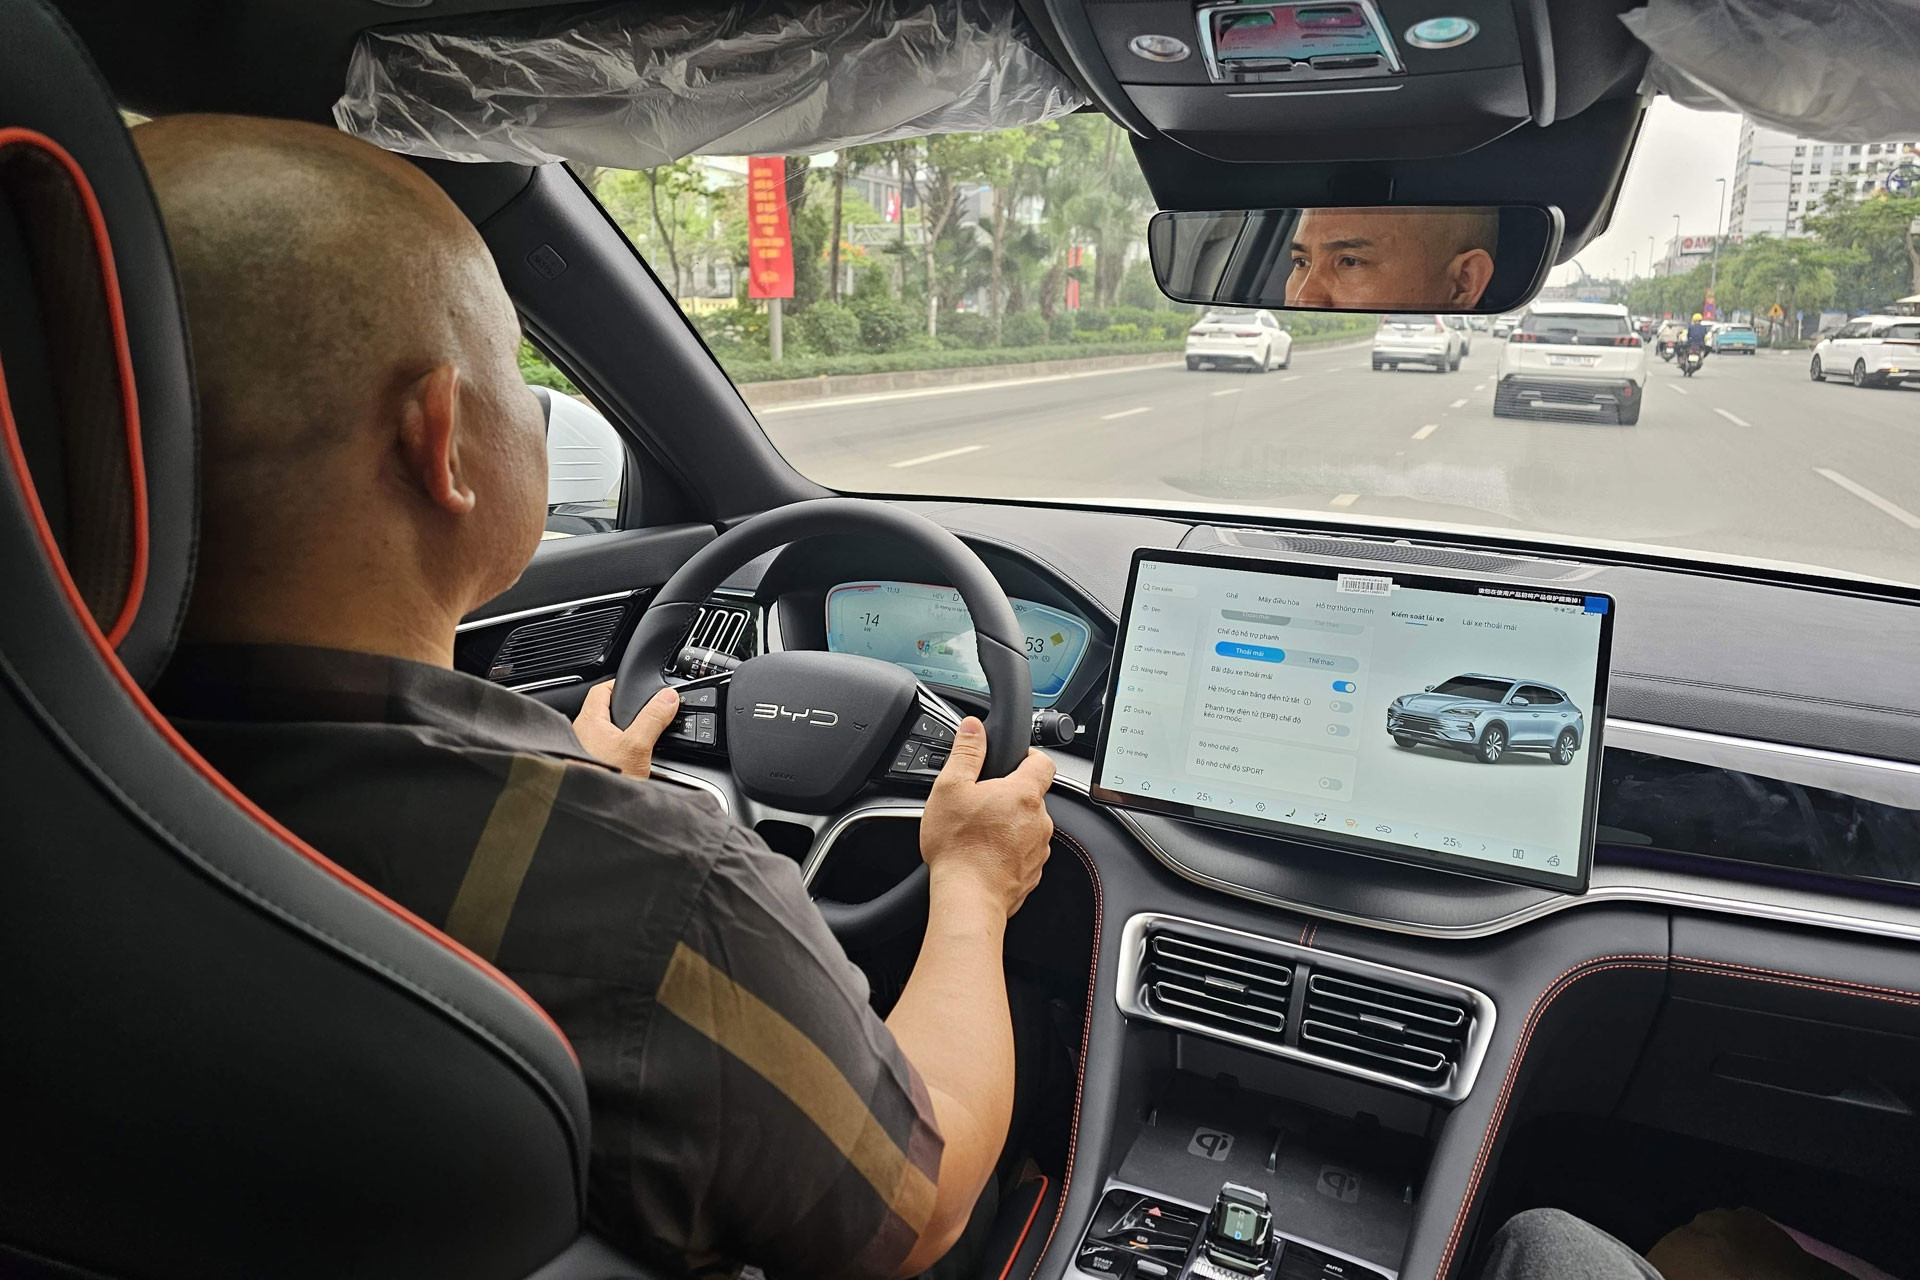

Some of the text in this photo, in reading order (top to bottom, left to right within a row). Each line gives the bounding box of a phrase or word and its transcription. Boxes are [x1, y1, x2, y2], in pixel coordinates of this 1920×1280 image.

[887, 586, 900, 594] 11:13
[952, 593, 960, 602] D
[859, 612, 880, 627] -14
[1260, 632, 1280, 641] phanh
[1025, 636, 1045, 653] 53
[1205, 703, 1225, 712] Phanh
[1226, 705, 1235, 714] tay
[752, 702, 839, 728] BYD
[1241, 766, 1264, 775] SPORT
[1093, 1256, 1113, 1266] START
[1093, 1262, 1109, 1270] STOP
[1325, 1263, 1343, 1273] AUTO
